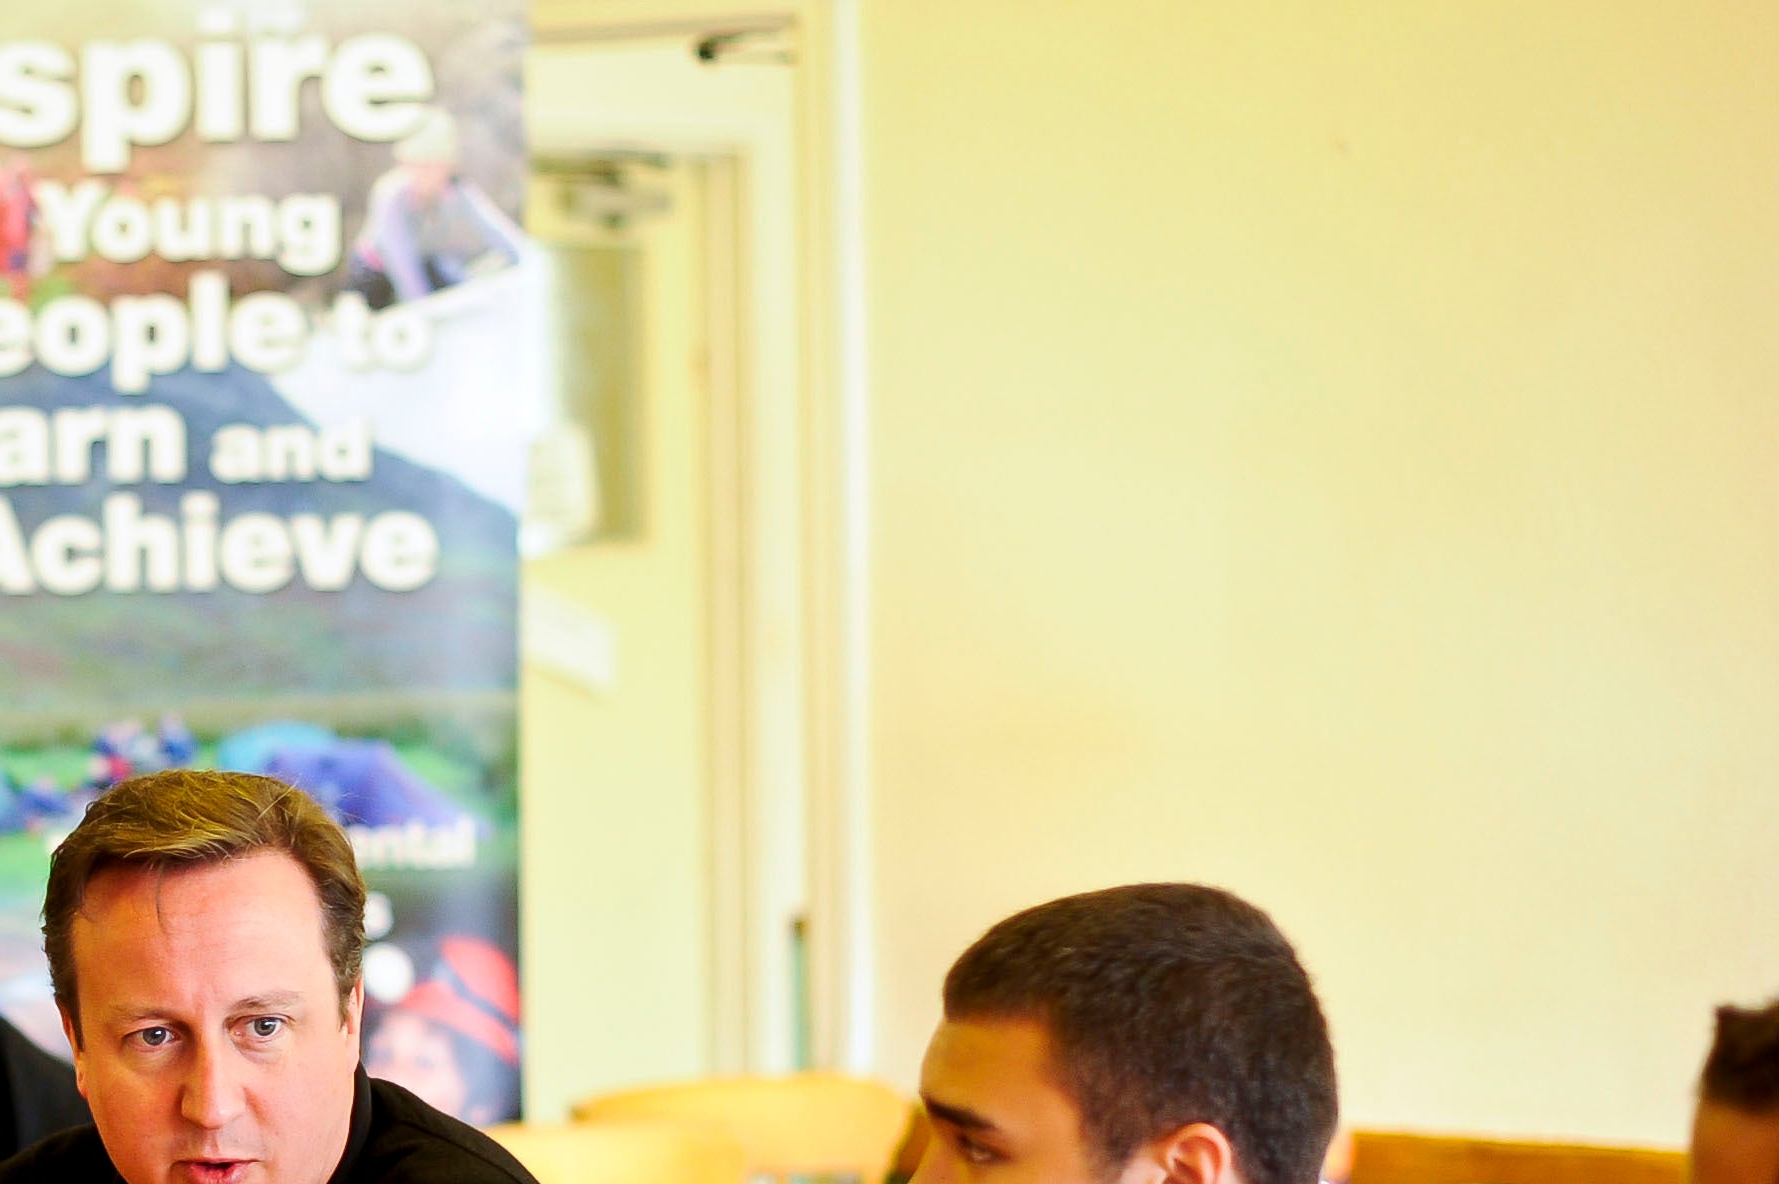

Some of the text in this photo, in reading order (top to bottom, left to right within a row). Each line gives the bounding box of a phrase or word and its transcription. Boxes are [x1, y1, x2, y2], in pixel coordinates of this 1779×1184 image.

[36, 180, 342, 275] Young
[330, 290, 432, 371] to
[211, 413, 374, 484] and
